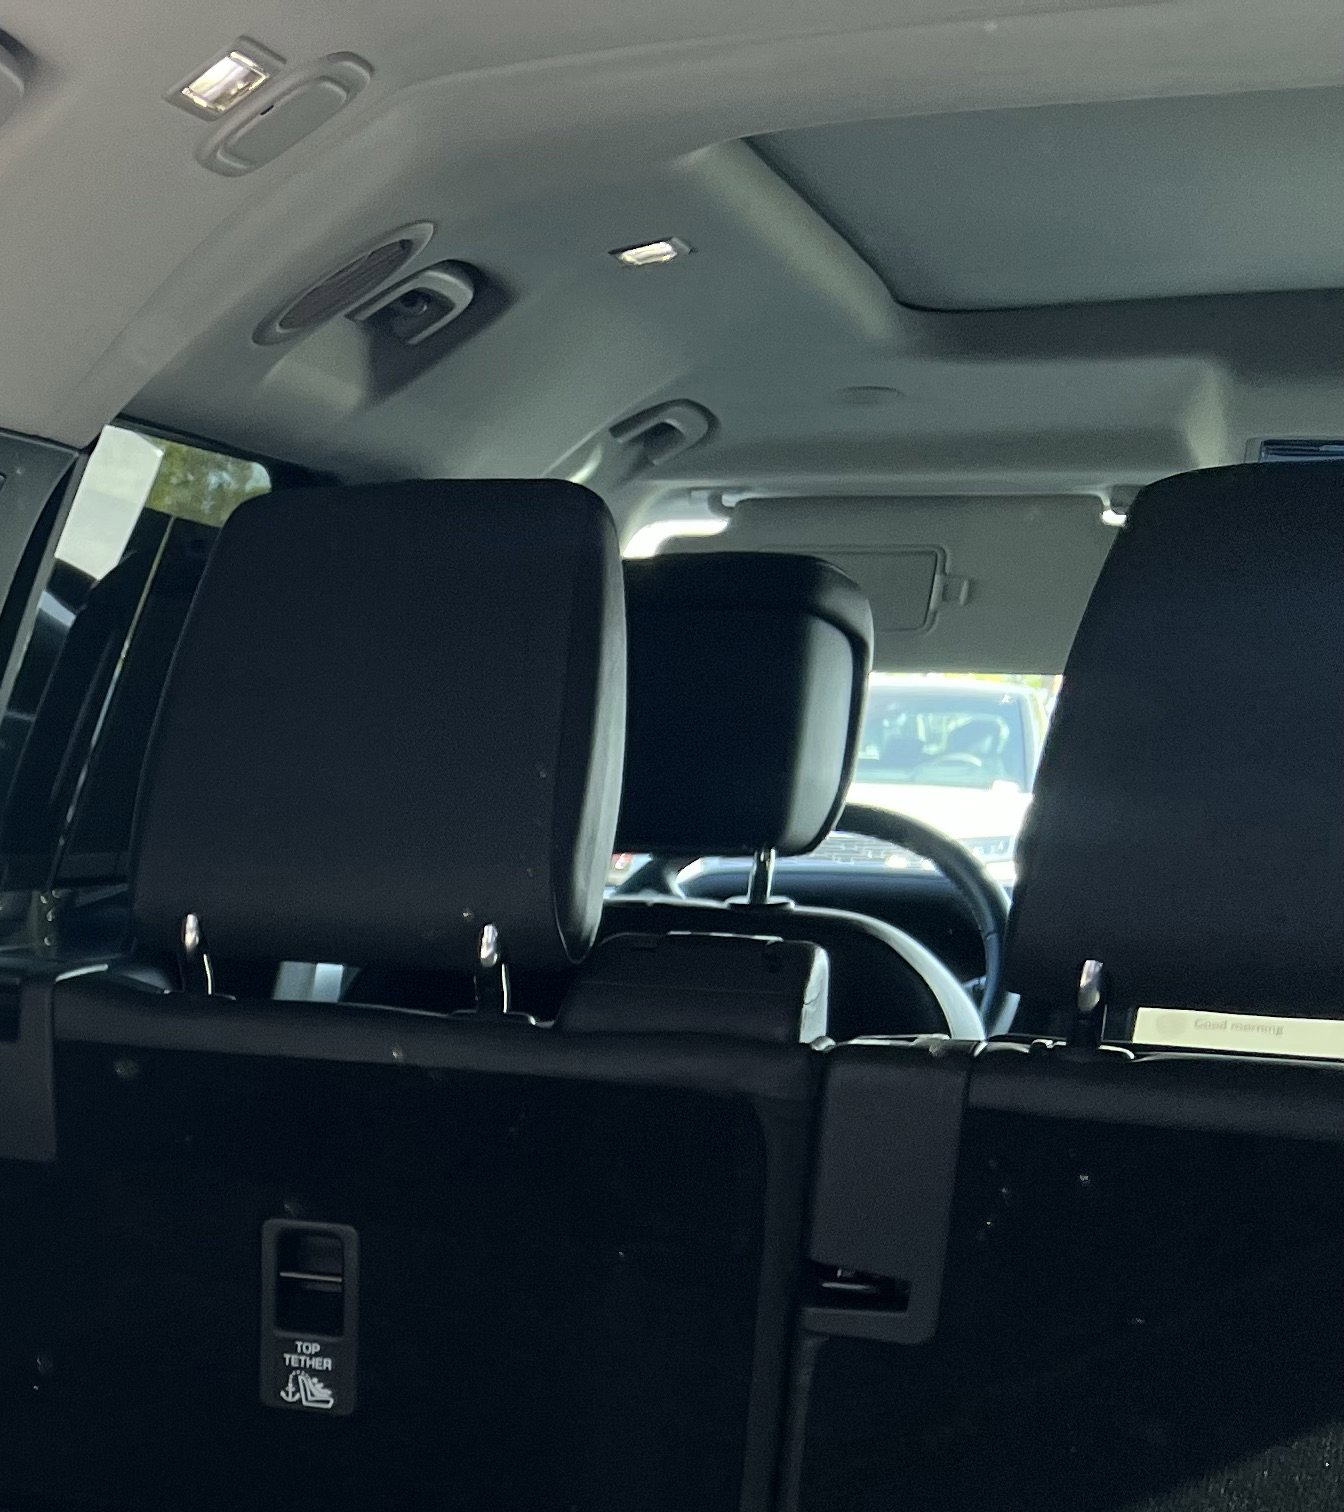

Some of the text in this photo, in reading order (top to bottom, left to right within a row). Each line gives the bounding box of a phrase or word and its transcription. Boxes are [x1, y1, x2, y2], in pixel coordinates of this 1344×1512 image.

[1194, 1018, 1227, 1031] Good
[295, 1341, 321, 1354] TOP
[283, 1353, 332, 1371] TETHER
